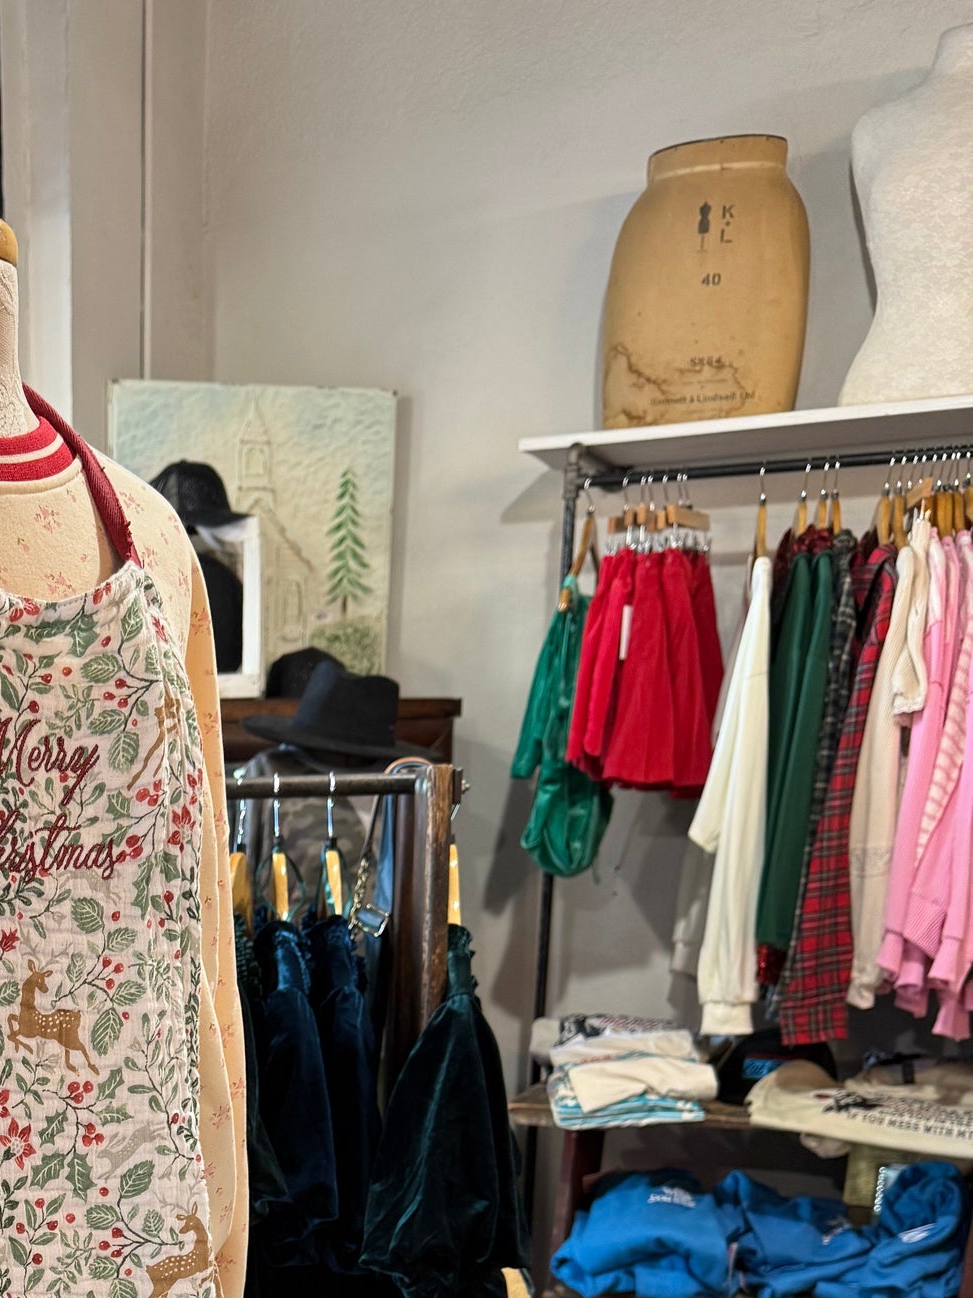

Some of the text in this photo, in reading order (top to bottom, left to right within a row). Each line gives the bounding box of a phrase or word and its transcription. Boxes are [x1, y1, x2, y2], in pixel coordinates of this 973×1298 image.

[722, 204, 735, 220] K
[720, 228, 733, 244] L
[701, 272, 722, 286] 40
[862, 1112, 885, 1126] YOU
[887, 1118, 920, 1132] MESS
[923, 1123, 955, 1137] WITH
